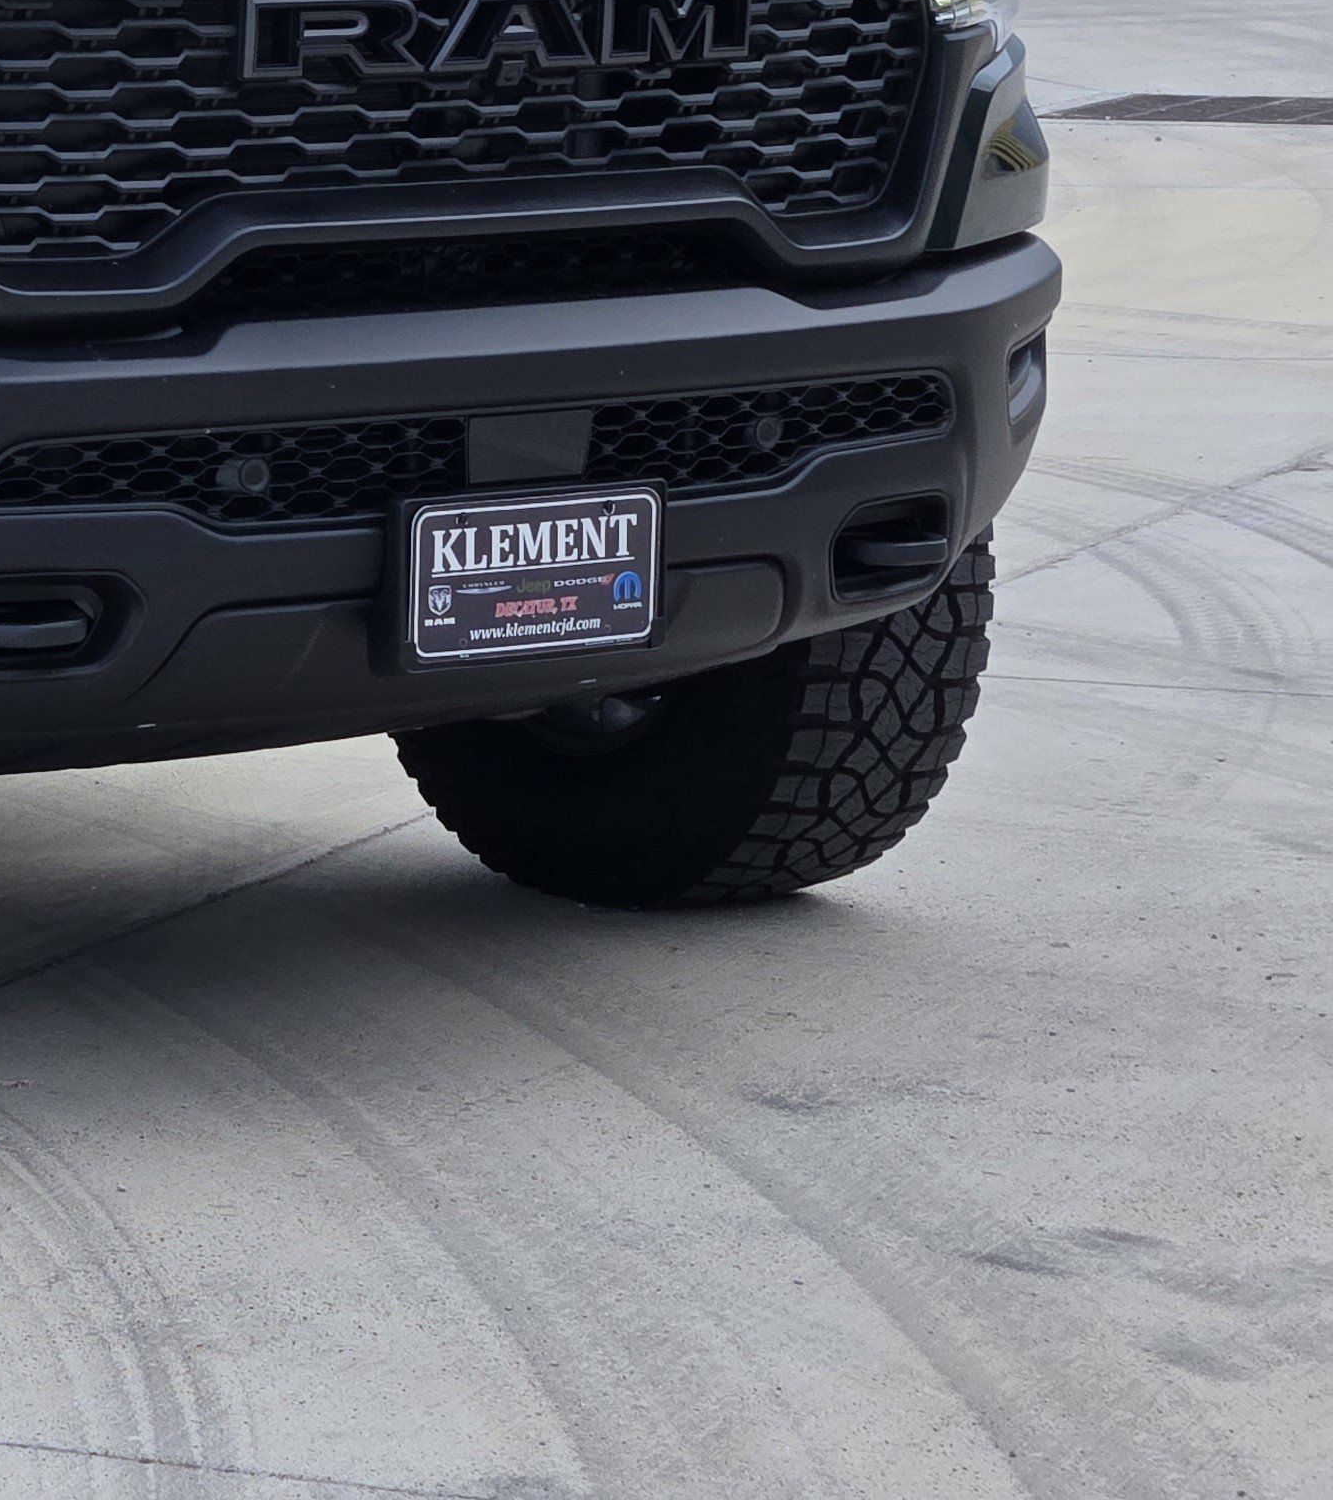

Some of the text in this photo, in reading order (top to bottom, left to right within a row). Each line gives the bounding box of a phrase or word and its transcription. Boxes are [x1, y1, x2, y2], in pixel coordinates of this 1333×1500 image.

[431, 513, 638, 573] KLEMENT
[553, 576, 605, 588] DODGE
[560, 596, 578, 612] TX
[424, 617, 455, 626] RAM
[469, 617, 601, 641] www.klementcjd.com
